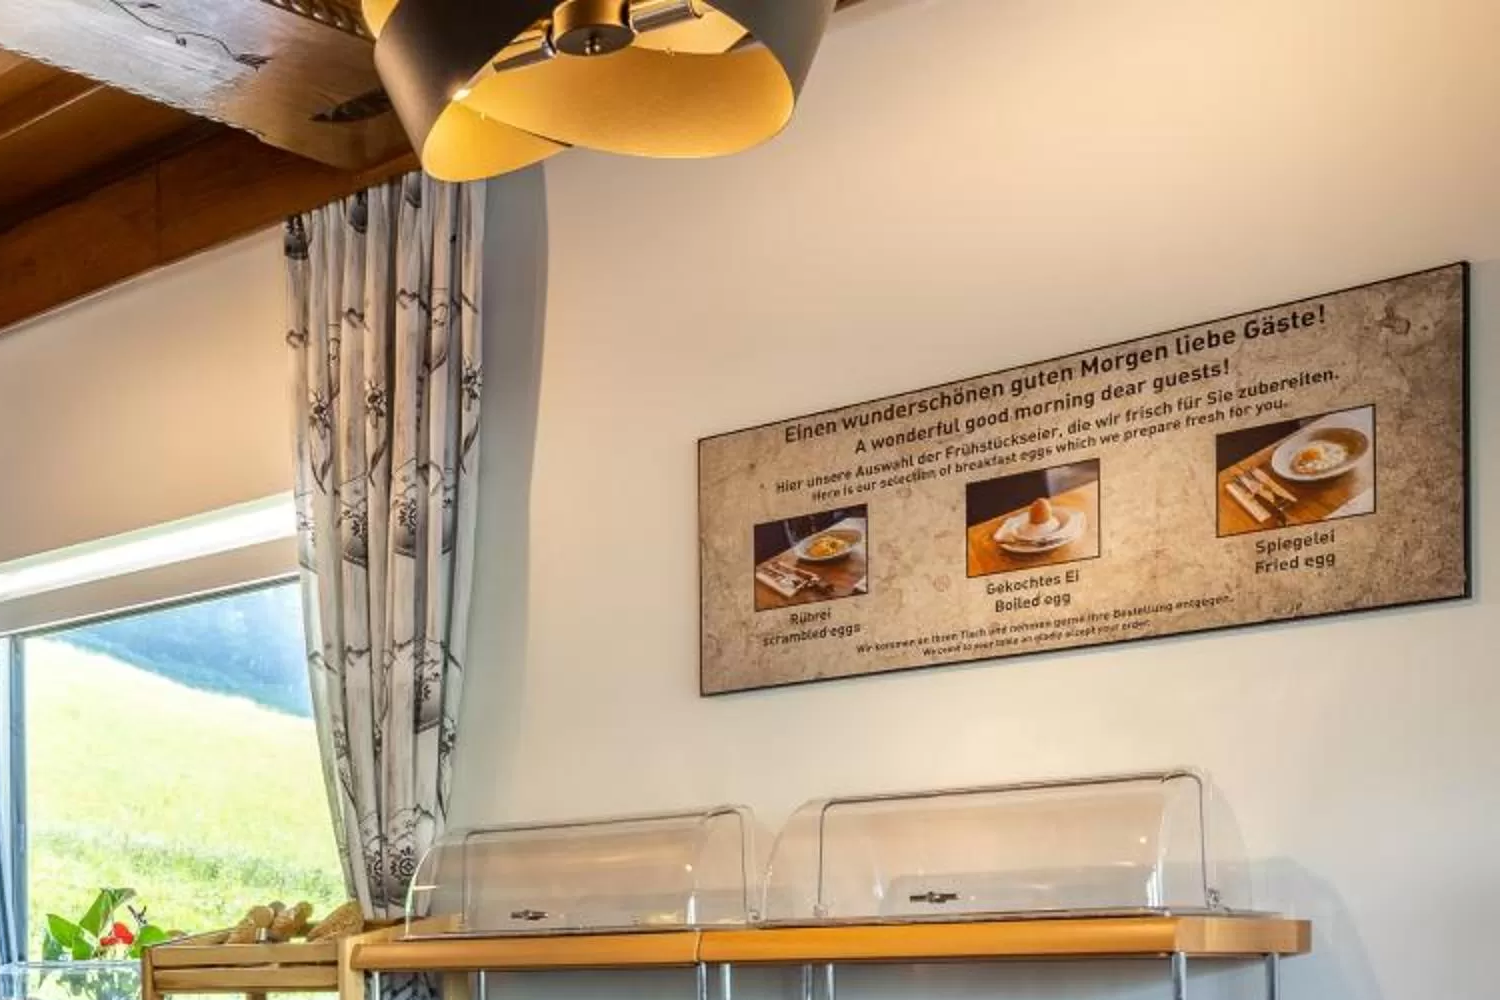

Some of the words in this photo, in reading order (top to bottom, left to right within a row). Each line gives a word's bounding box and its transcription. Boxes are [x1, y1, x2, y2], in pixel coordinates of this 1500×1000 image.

[784, 419, 837, 444] Einen
[841, 382, 1005, 430] wunderschönen
[1011, 366, 1073, 396] guten
[1081, 345, 1168, 377] Morgen
[1175, 327, 1236, 355] liebe
[1243, 304, 1326, 340] Gäste!
[855, 440, 867, 454] A
[870, 418, 960, 450] wonderful
[965, 408, 1009, 433] good
[1015, 392, 1095, 420] morning
[1101, 380, 1147, 401] dear
[1153, 358, 1230, 390] guests!
[776, 479, 803, 493] Hier
[807, 470, 852, 488] unsere
[855, 455, 914, 478] Auswahl
[917, 450, 943, 465] der
[945, 426, 1063, 459] Frühstückseier,
[1067, 419, 1091, 434] die
[1095, 412, 1120, 428] wir
[1125, 401, 1173, 422] frisch
[1177, 395, 1202, 411] für
[1207, 390, 1233, 405] Sie
[1238, 369, 1340, 399] zubereiten.
[843, 484, 854, 496] is
[856, 481, 876, 493] our
[880, 469, 936, 489] selection
[939, 464, 951, 476] of
[955, 452, 1017, 473] breakfast
[1019, 446, 1052, 461] eggs
[1056, 436, 1096, 453] which
[1100, 432, 1120, 444] we
[1123, 419, 1181, 442] prepare
[1185, 409, 1225, 427] fresh
[1229, 404, 1251, 419] for
[1255, 528, 1335, 556] Spiegelei
[1255, 555, 1299, 575] Fried
[1304, 553, 1336, 569] egg
[986, 575, 1061, 595] Gekochtes
[1065, 569, 1079, 584] Ei
[995, 591, 1041, 612] Boiled
[1044, 593, 1071, 607] egg
[763, 624, 827, 647] scrambled
